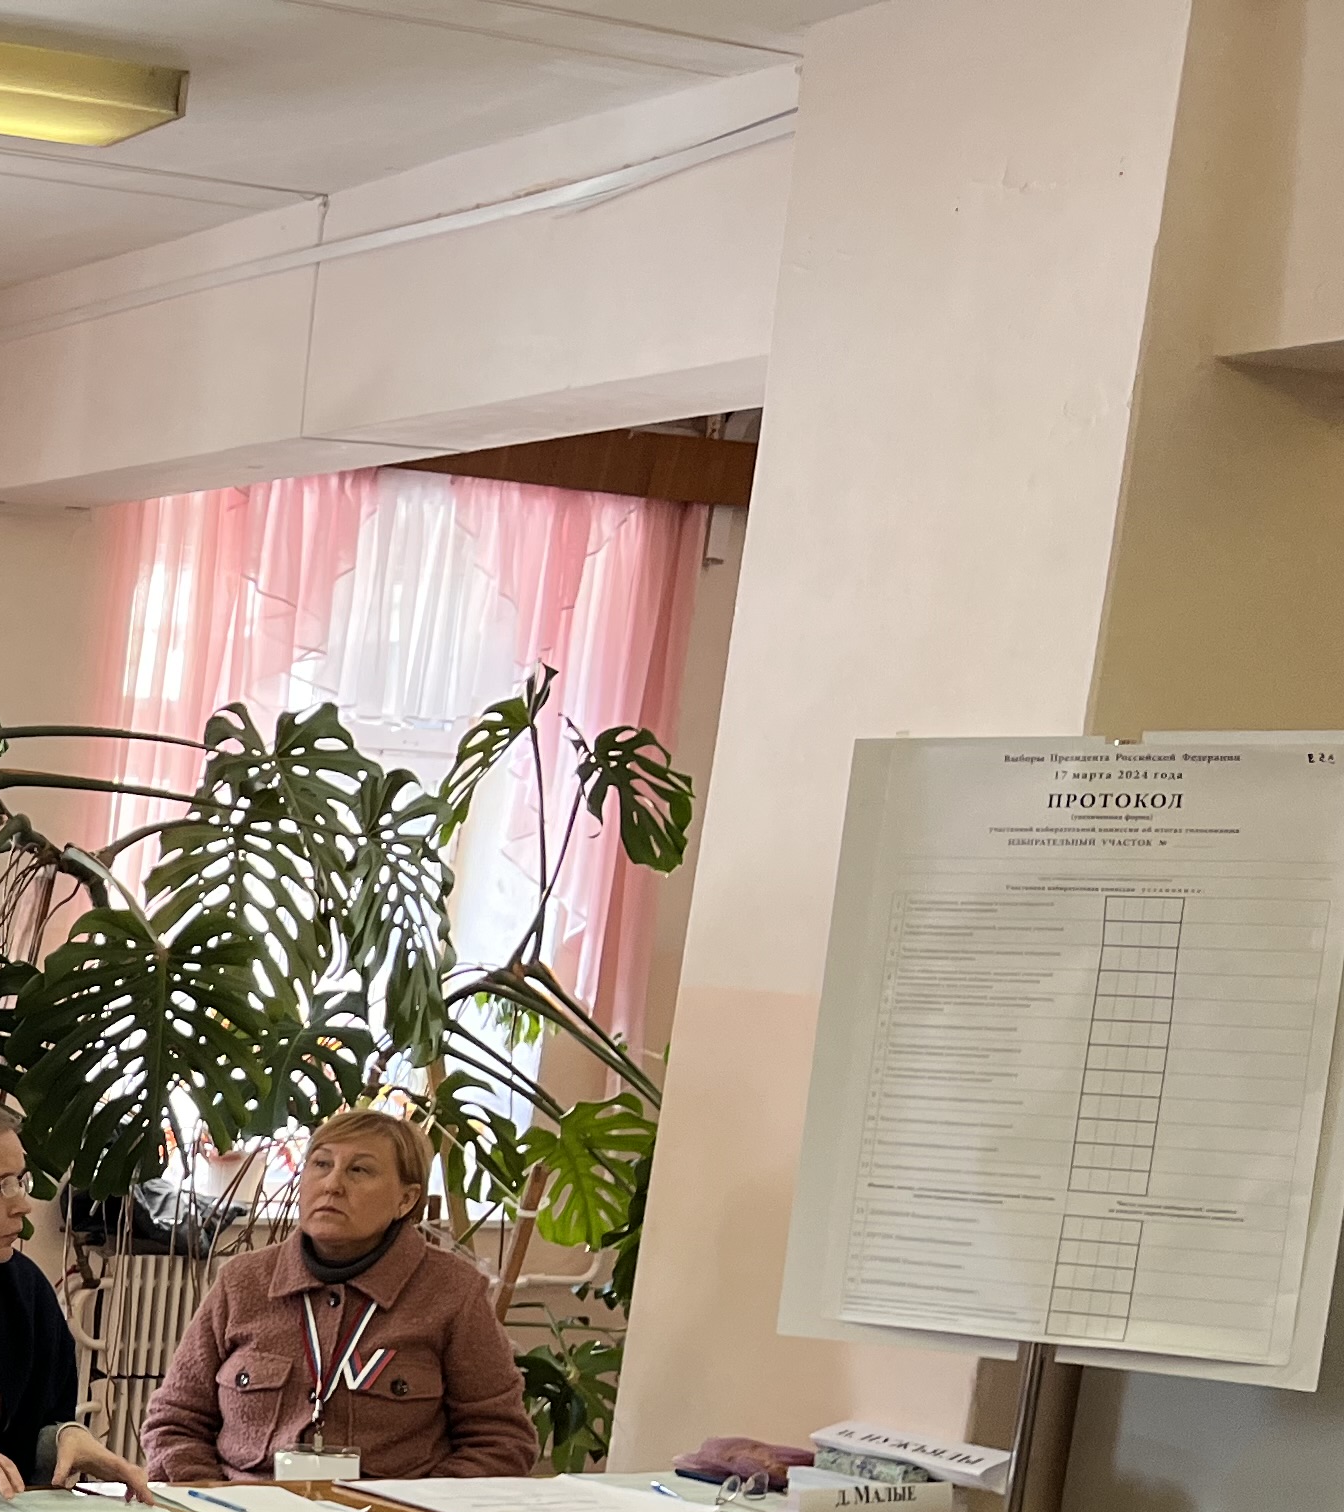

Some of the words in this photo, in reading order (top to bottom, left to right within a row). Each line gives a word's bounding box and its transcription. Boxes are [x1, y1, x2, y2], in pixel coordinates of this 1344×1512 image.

[1050, 753, 1110, 763] Президента
[1054, 770, 1068, 780] 17
[1072, 771, 1112, 782] марта
[1117, 769, 1148, 780] 2024
[1153, 770, 1184, 781] года
[1046, 792, 1184, 809] ПРОТОКОЛ
